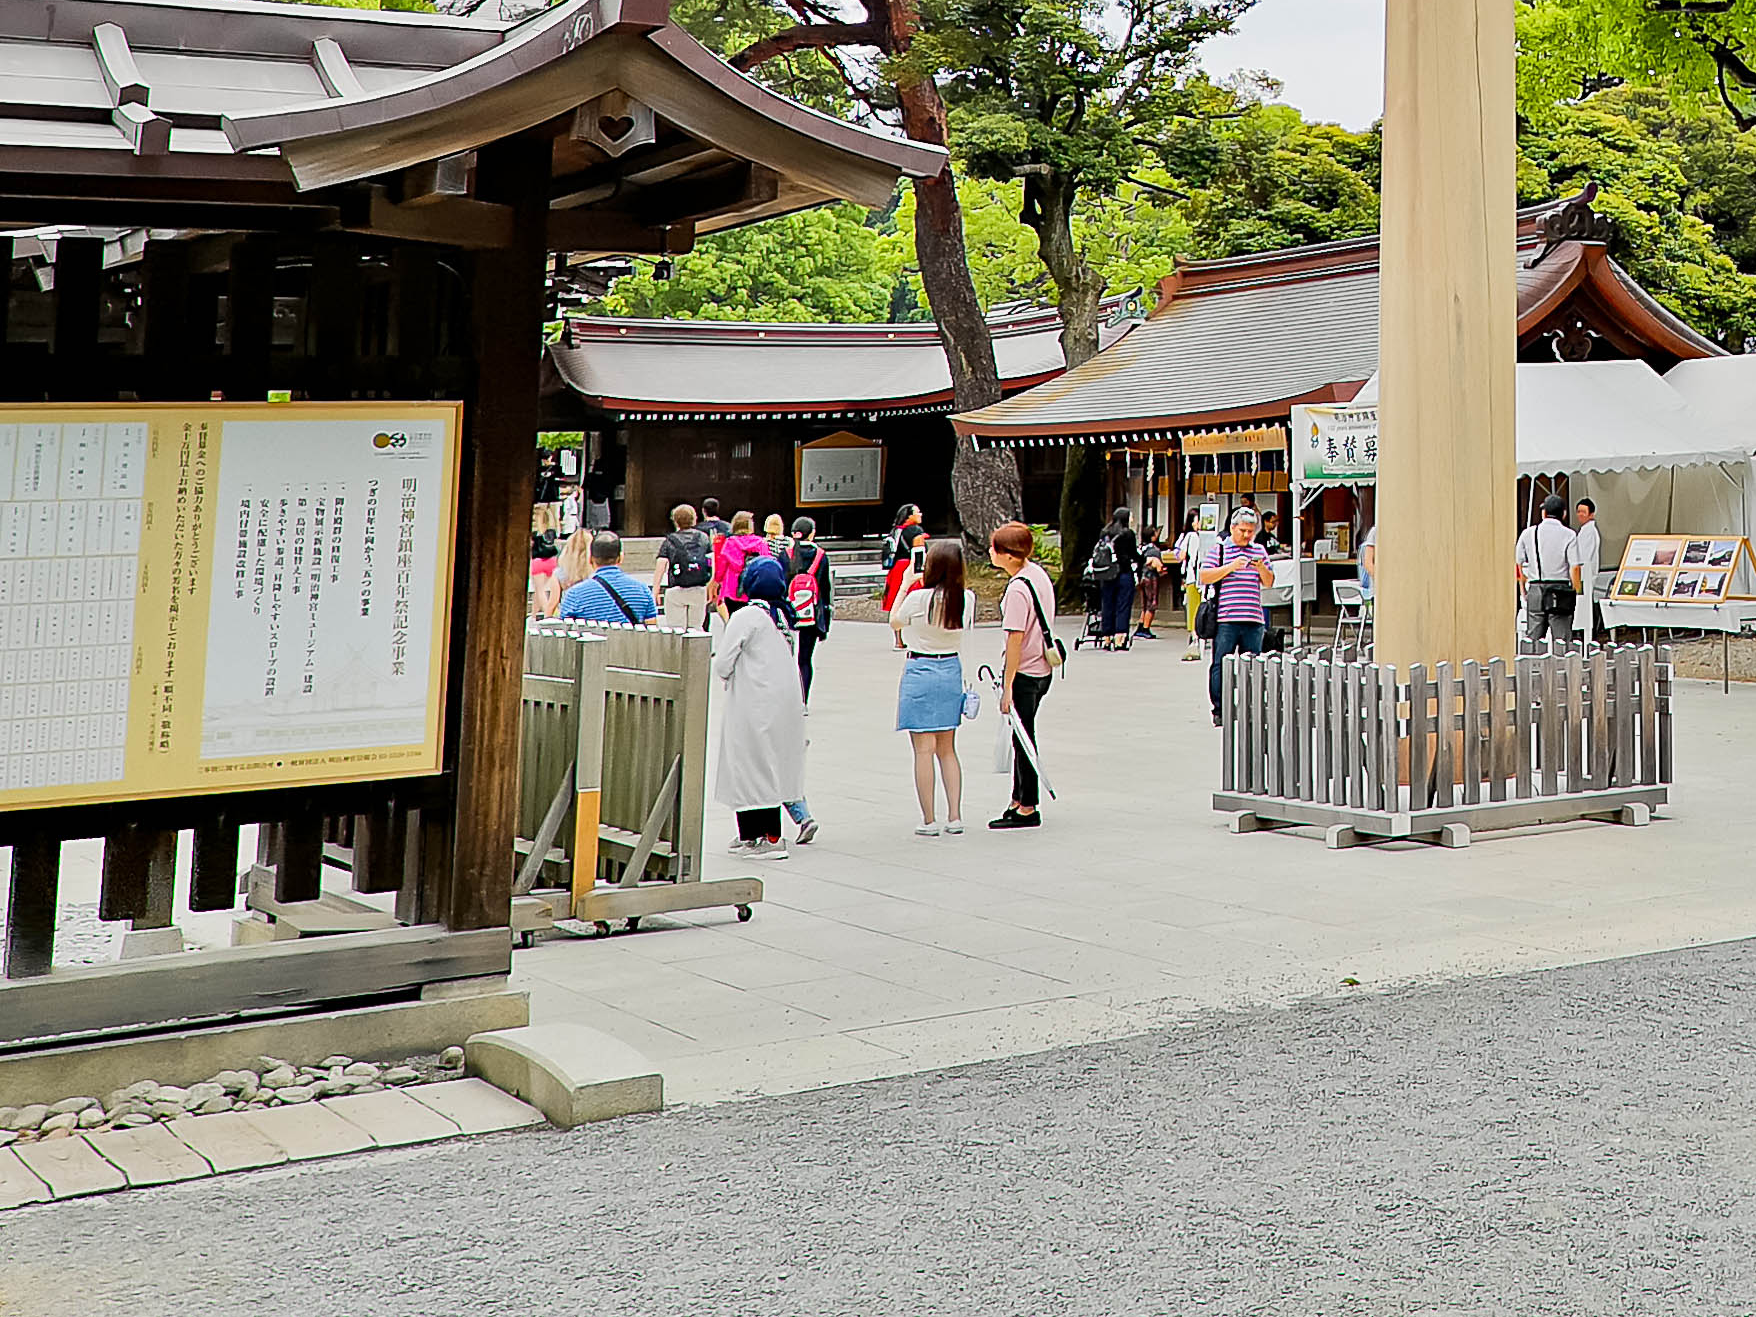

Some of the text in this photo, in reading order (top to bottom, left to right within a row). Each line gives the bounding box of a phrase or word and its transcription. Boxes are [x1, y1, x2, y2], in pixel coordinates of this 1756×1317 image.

[392, 478, 417, 676] 明治神宮鎮座百年祭記念事業
